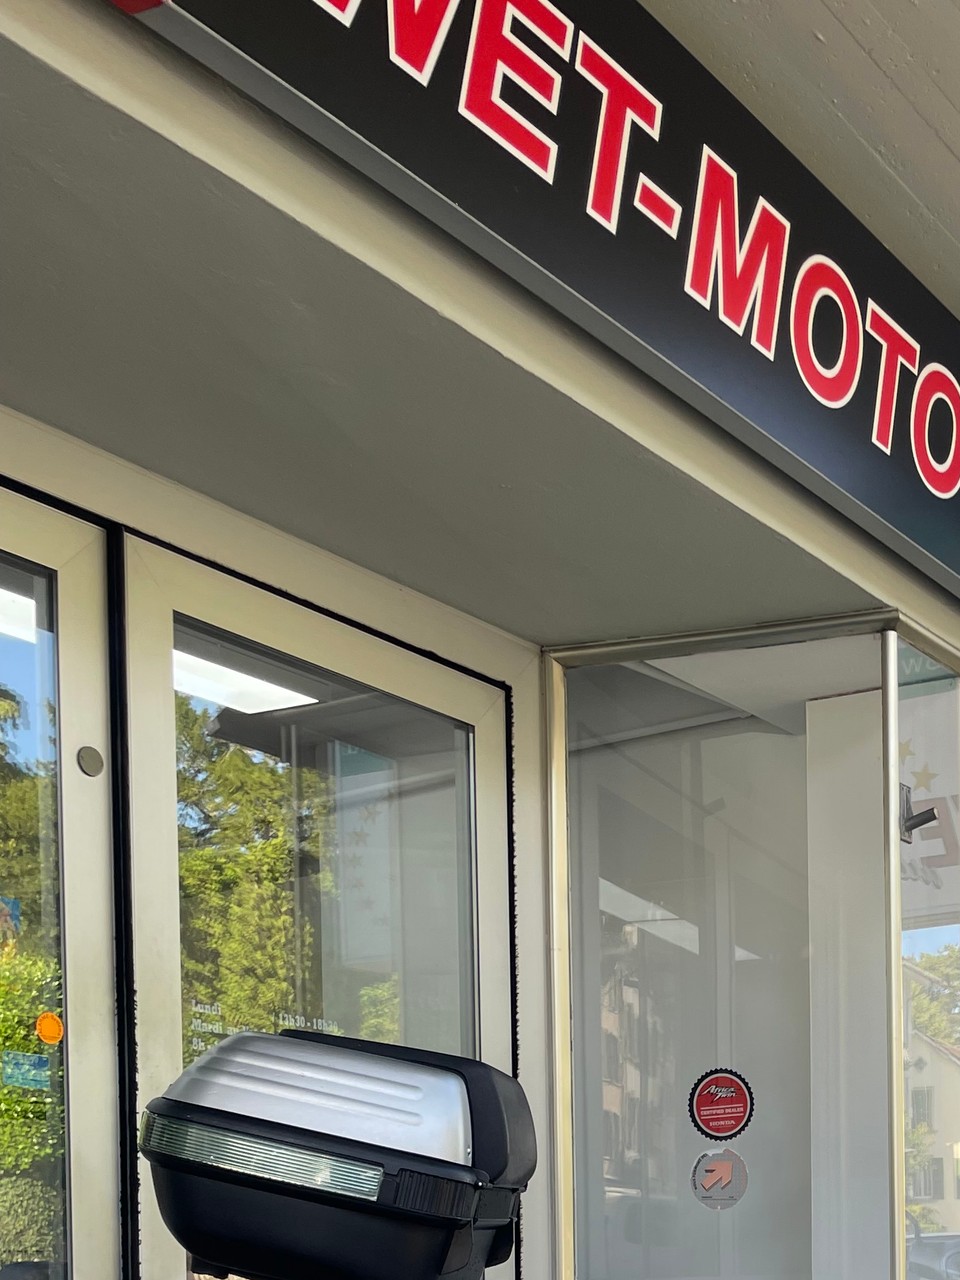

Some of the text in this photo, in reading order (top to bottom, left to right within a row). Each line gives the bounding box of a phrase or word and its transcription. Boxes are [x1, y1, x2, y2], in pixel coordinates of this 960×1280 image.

[191, 999, 222, 1015] Lundi
[279, 1013, 306, 1028] 13h30
[312, 1018, 339, 1032] 18h30
[191, 1018, 223, 1034] Mardi
